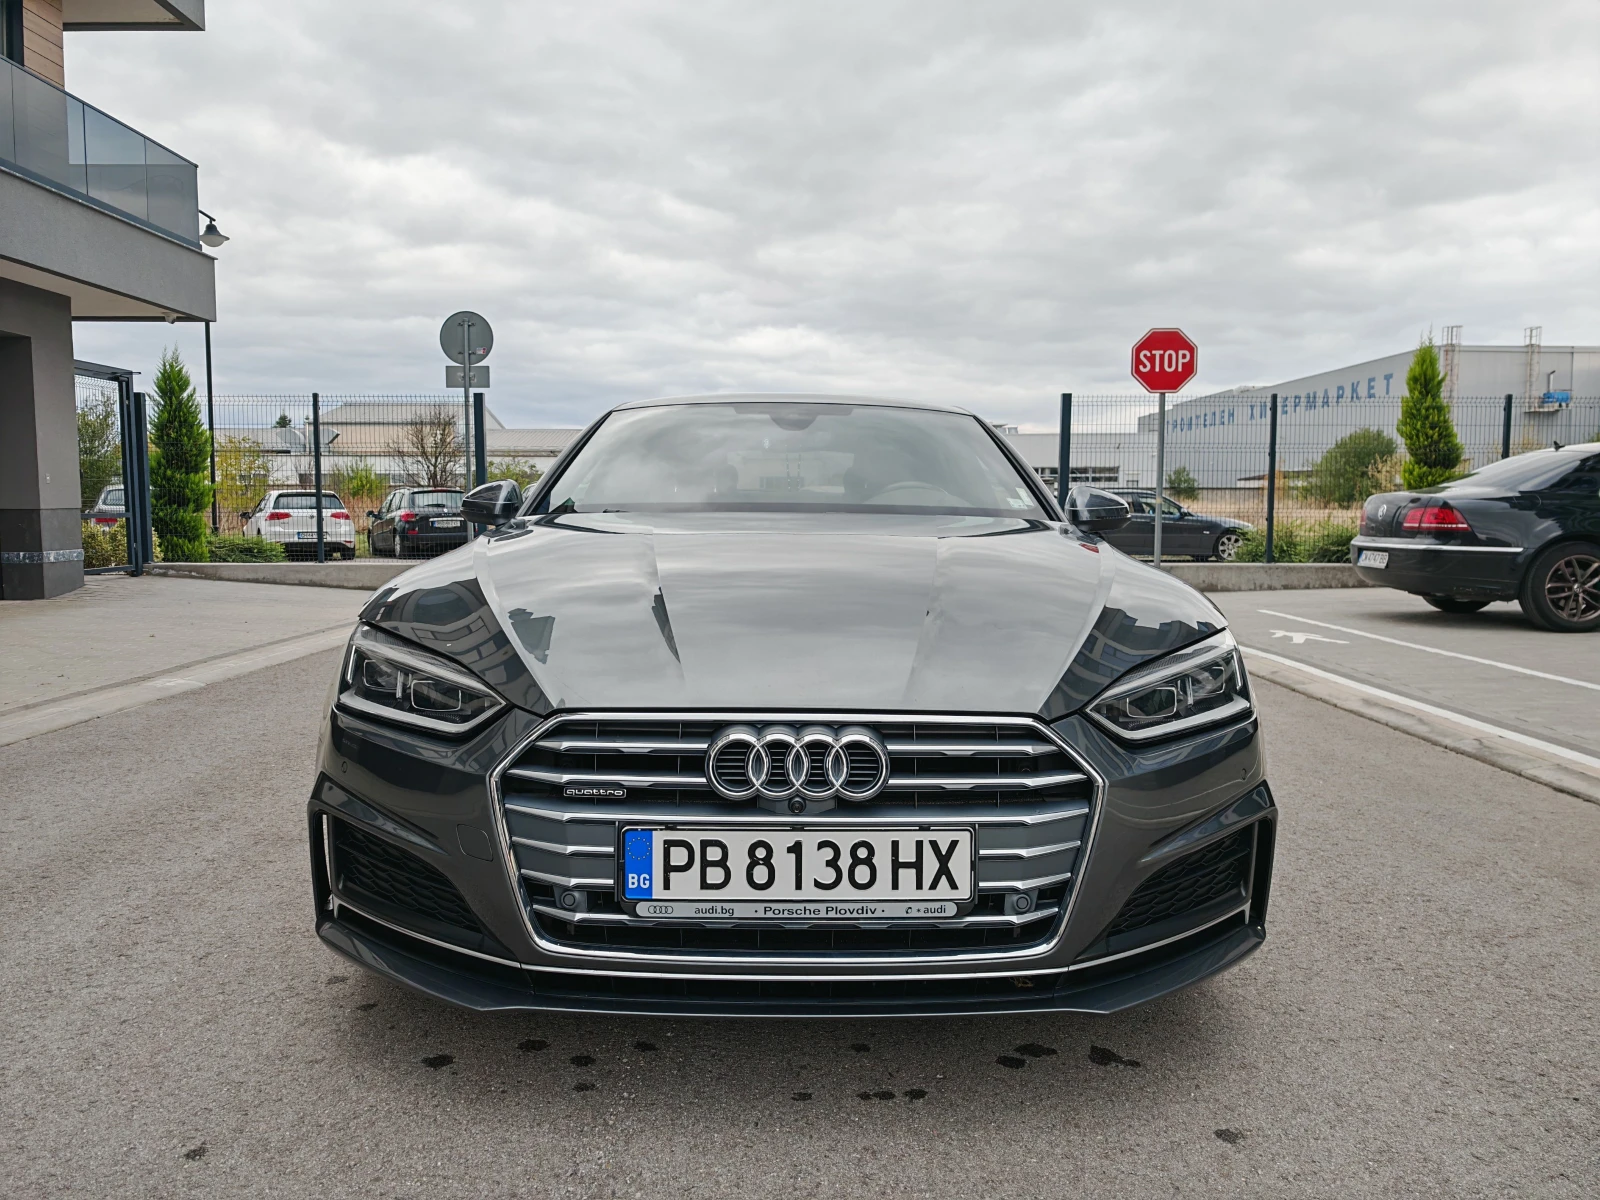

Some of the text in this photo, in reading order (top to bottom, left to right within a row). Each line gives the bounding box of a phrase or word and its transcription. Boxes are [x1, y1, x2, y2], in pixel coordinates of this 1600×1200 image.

[1139, 350, 1191, 373] STOP
[1166, 373, 1394, 434] ТРОИТЕЛЕН ХИЕРМАРКЕТ
[566, 788, 623, 796] quattro
[662, 839, 960, 891] PB 8138 HX
[628, 873, 650, 889] BG
[694, 905, 735, 916] audi.bg
[763, 905, 821, 916] Porsche
[825, 905, 877, 915] Plovdiv
